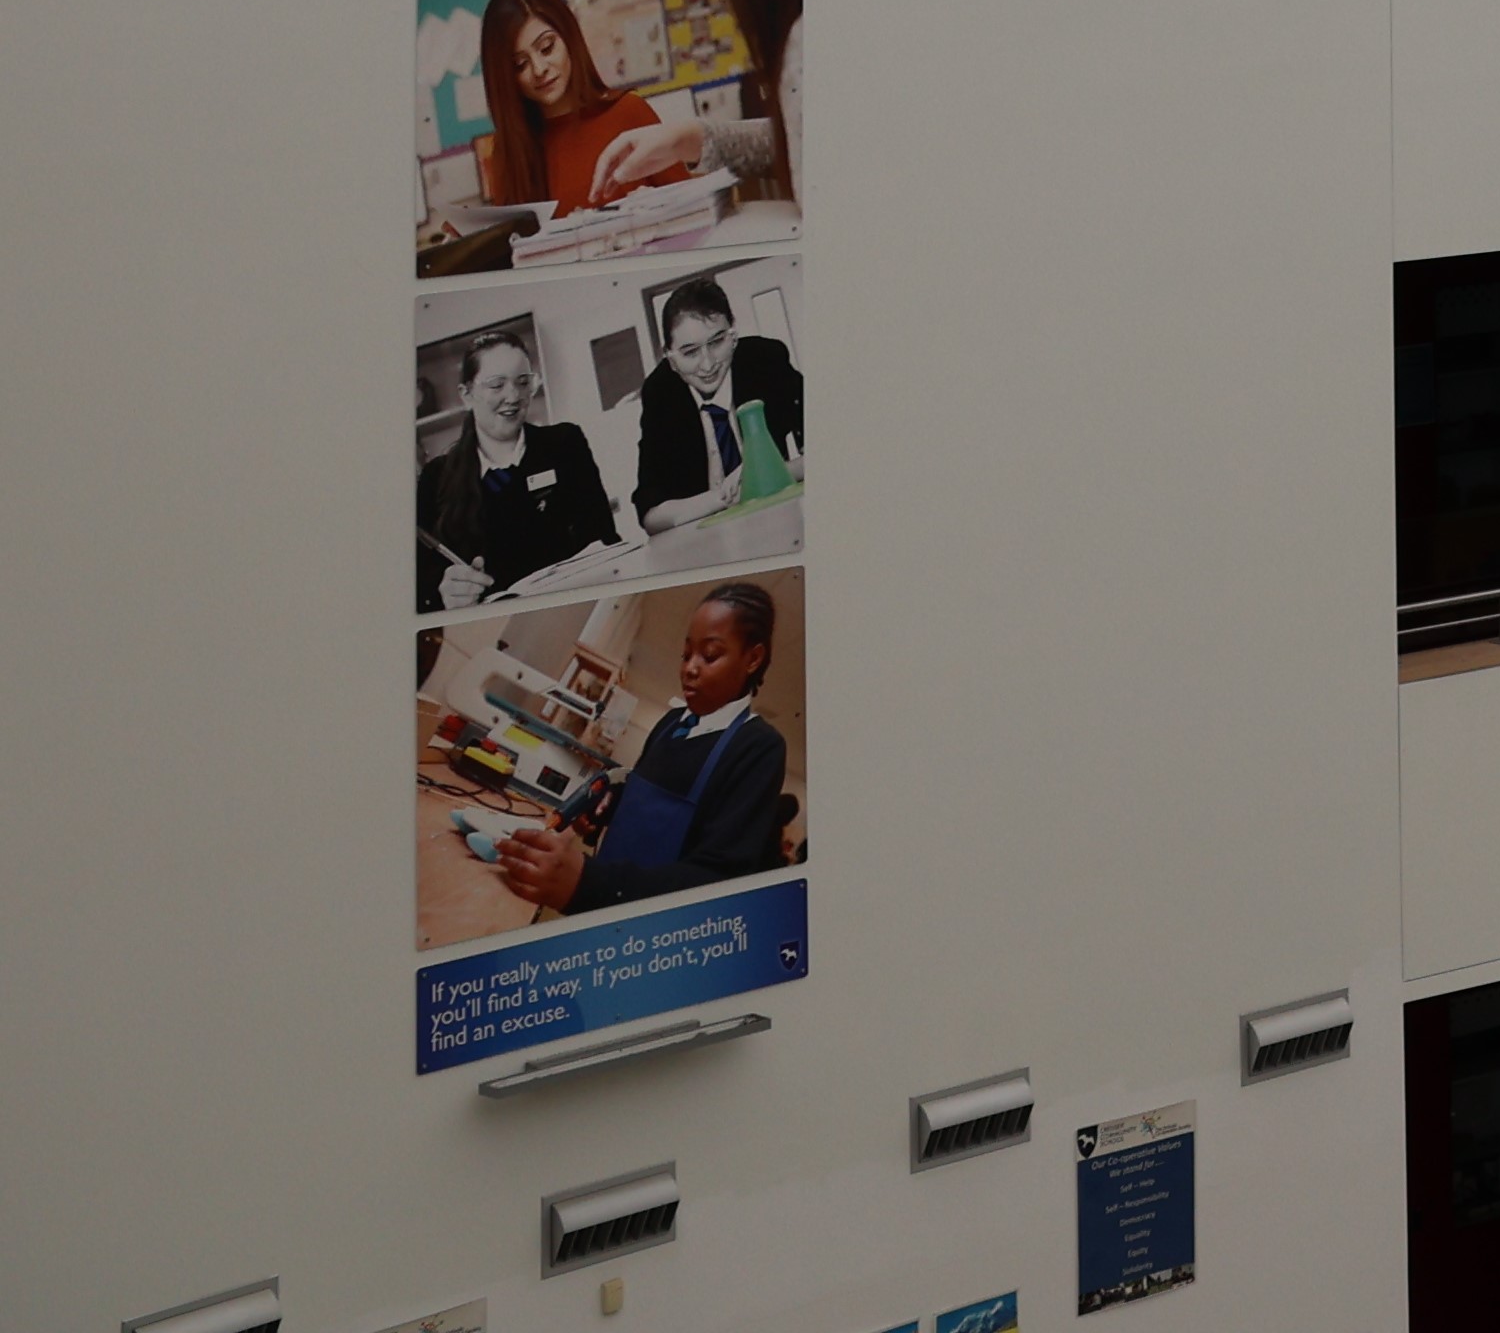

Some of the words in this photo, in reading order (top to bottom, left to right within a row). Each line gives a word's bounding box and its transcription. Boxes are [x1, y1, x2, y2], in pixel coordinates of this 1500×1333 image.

[431, 996, 481, 1033] you'll
[488, 985, 522, 1014] find
[528, 988, 538, 1004] a
[544, 976, 582, 1003] way.
[593, 966, 606, 986] If
[609, 960, 643, 990] you
[649, 946, 699, 976] don't,
[701, 932, 748, 967] you'll
[432, 983, 444, 1003] If
[449, 977, 485, 1006] you
[491, 961, 540, 989] really
[546, 951, 591, 974] want
[596, 944, 616, 964] to
[622, 935, 647, 955] do
[652, 915, 747, 950] something,
[431, 1024, 468, 1053] find
[473, 1022, 496, 1043] an
[501, 1003, 570, 1036] excuse.
